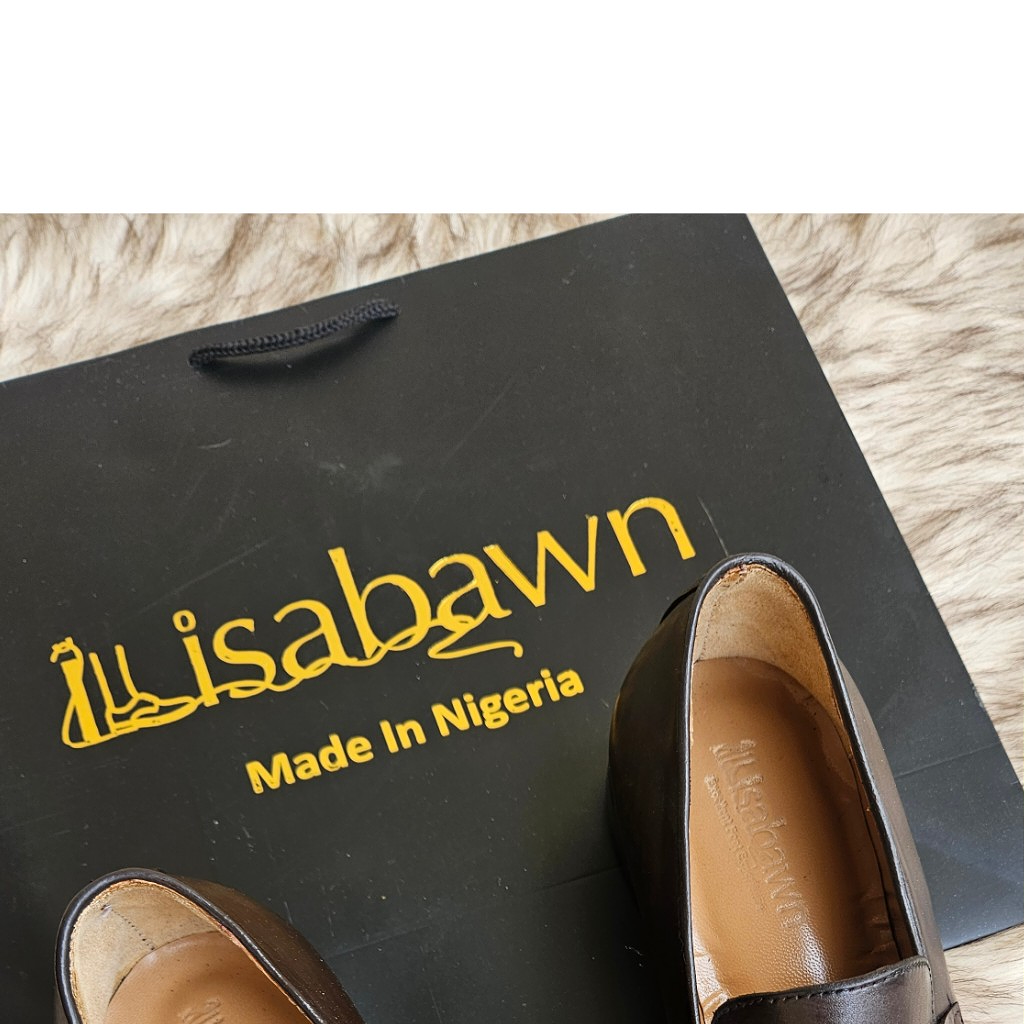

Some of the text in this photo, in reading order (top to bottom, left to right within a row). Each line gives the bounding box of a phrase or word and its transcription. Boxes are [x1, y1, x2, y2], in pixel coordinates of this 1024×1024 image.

[245, 667, 586, 795] Made In Nigeria
